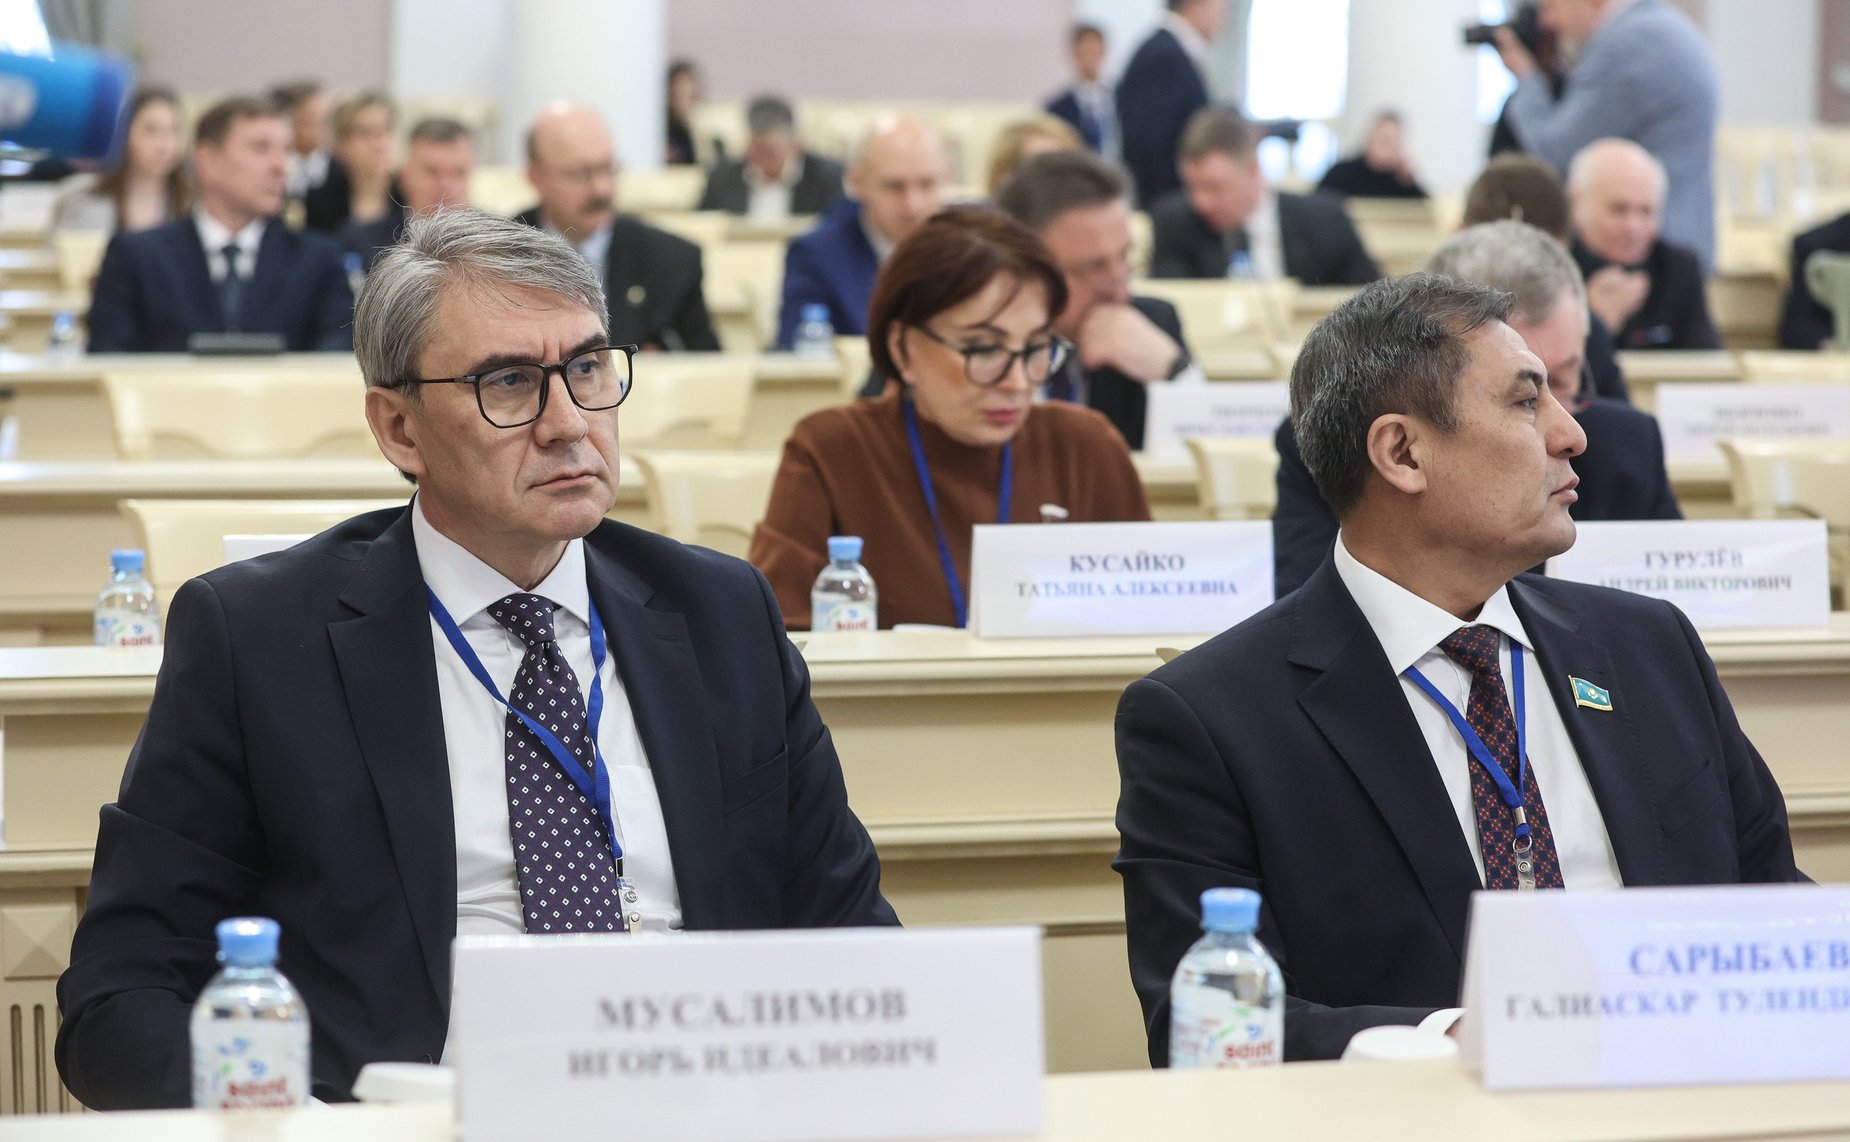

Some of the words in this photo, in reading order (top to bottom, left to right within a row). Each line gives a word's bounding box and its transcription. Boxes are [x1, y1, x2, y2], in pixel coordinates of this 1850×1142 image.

[1069, 550, 1185, 572] КУСАЙКО
[1645, 547, 1743, 569] ГУРУЛЁВ
[1015, 580, 1105, 598] ТАТЬЯНА
[1111, 579, 1238, 596] АЛЕКСЕЕВНА
[1673, 575, 1792, 592] ВИКТОРОВИЧ
[1629, 940, 1850, 976] САРЫБАЕВ
[597, 988, 907, 1030] МУСАЛИМОВ
[1505, 990, 1699, 1021] ГАЛИАСКАР
[568, 1045, 694, 1078] ИГОРЬ
[704, 1038, 937, 1073] ИДЕАЛОВИЧ
